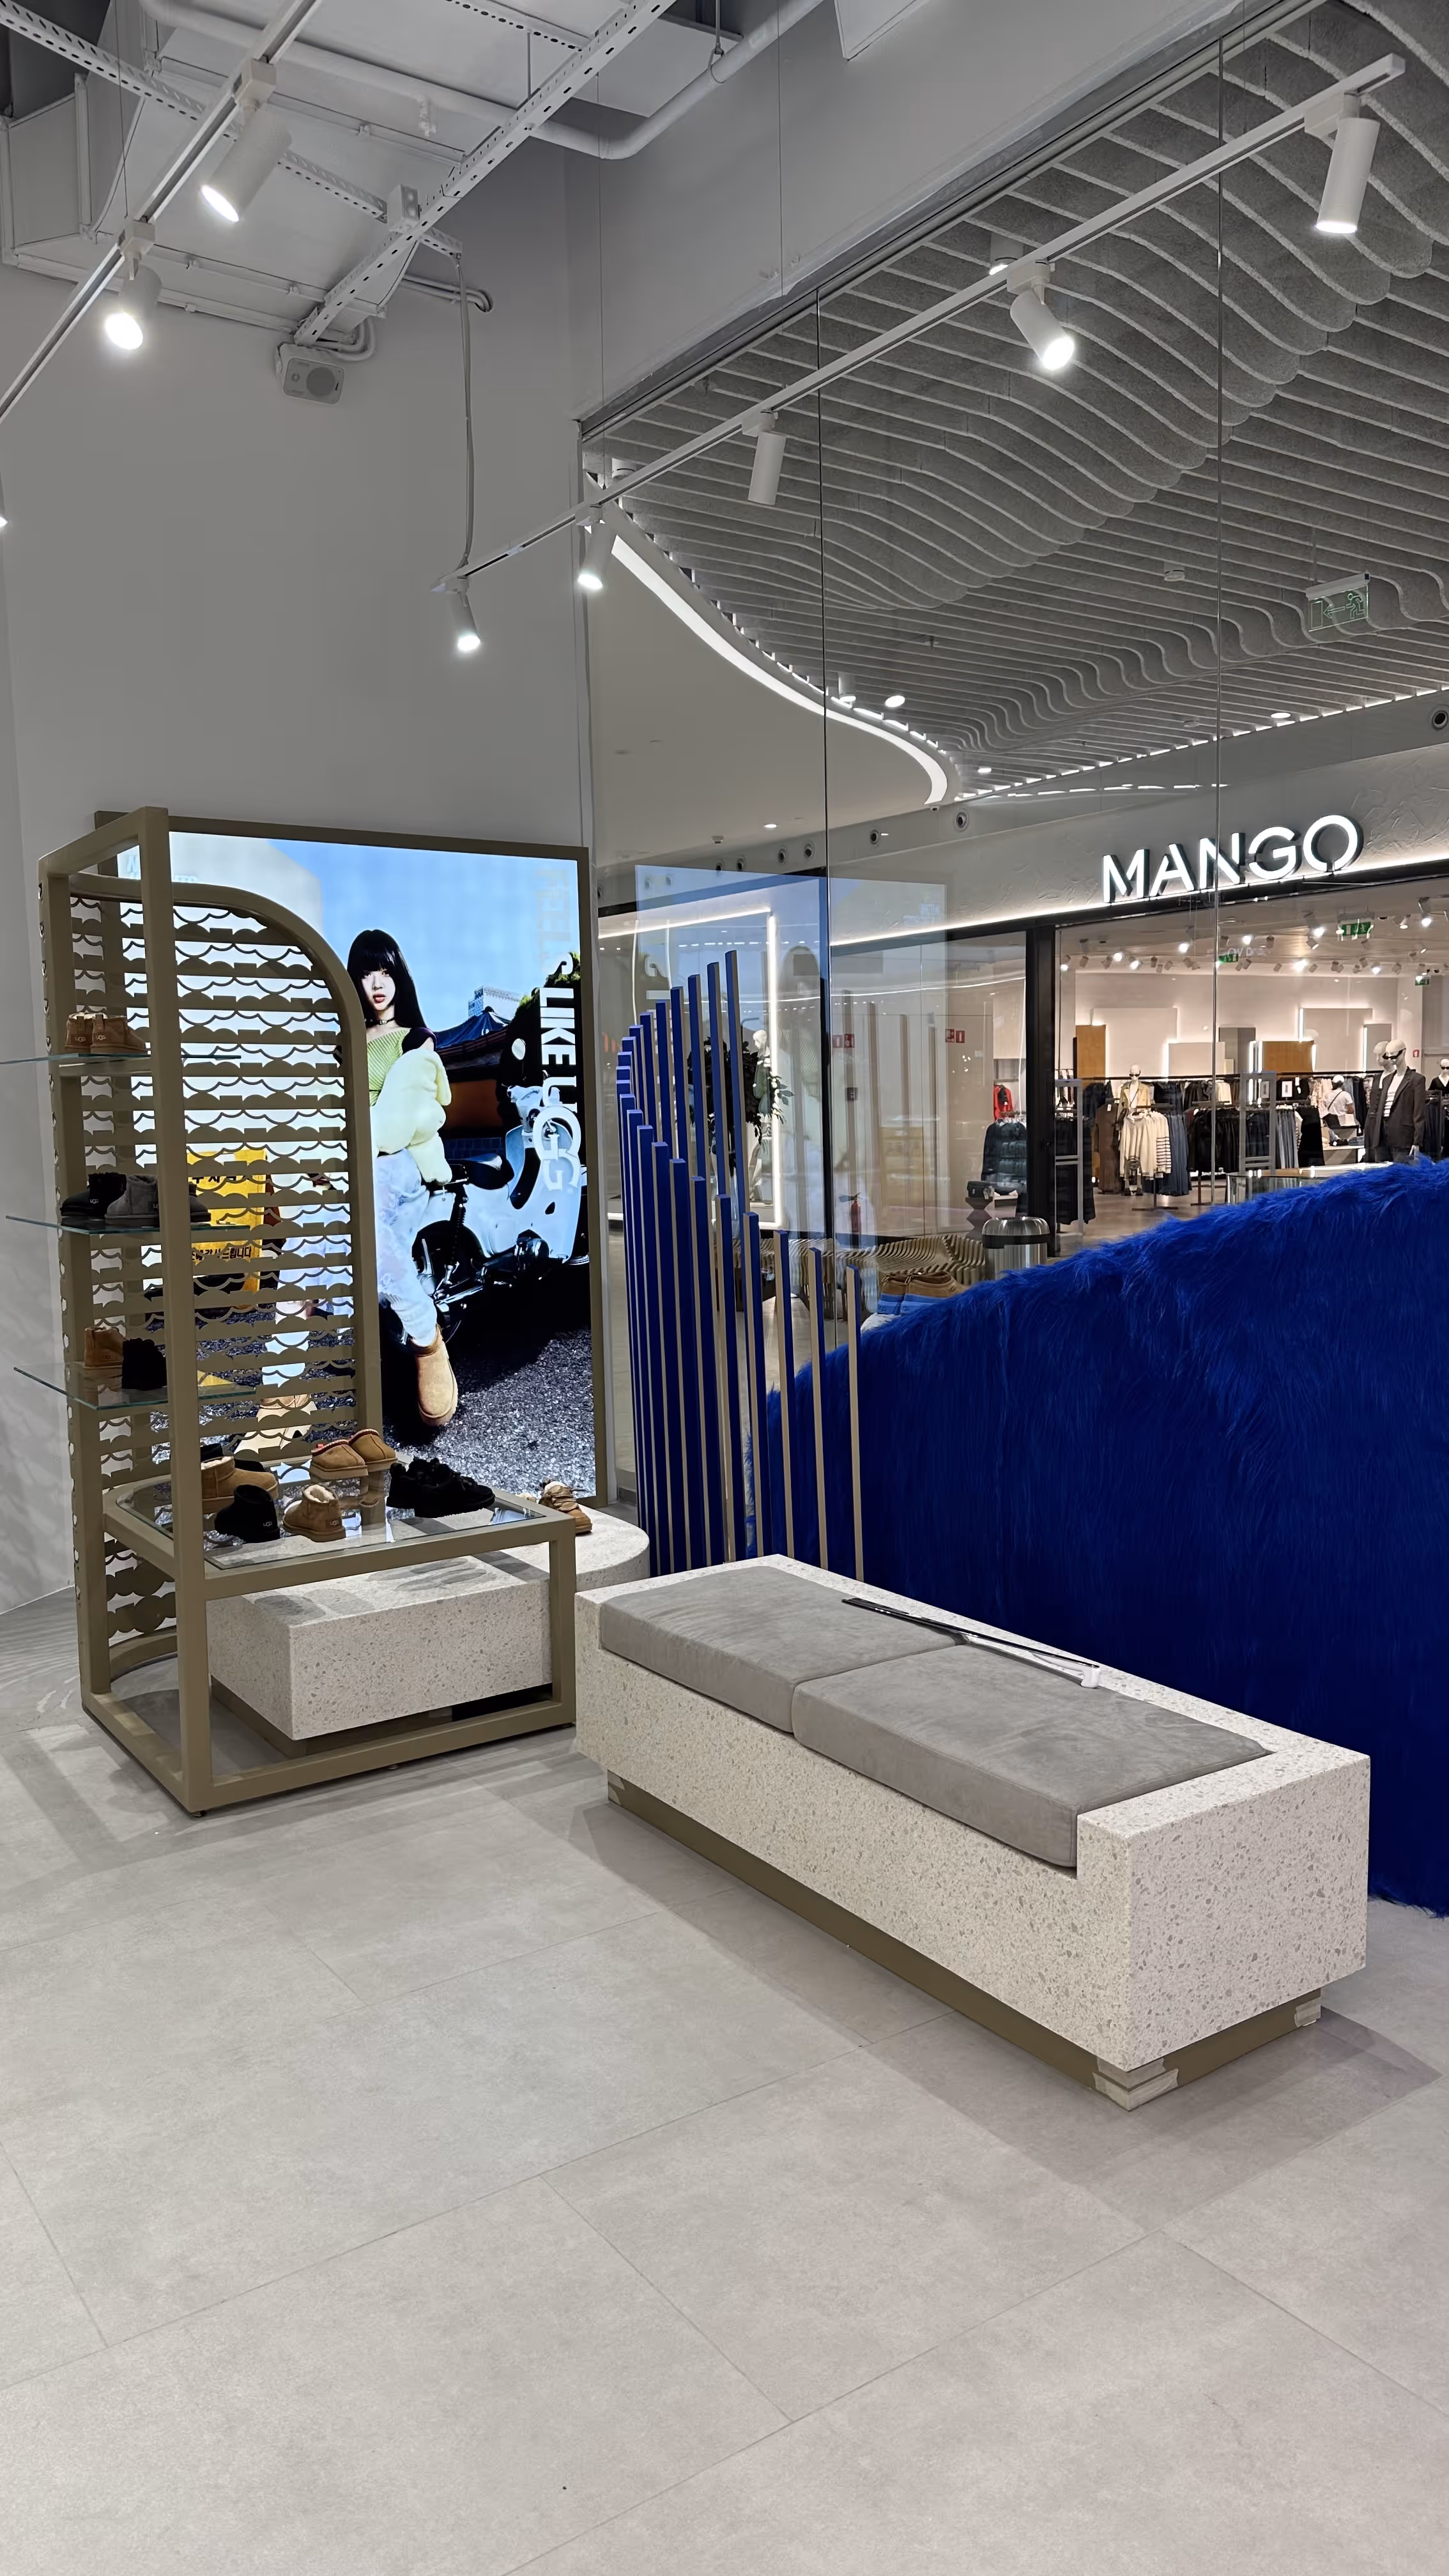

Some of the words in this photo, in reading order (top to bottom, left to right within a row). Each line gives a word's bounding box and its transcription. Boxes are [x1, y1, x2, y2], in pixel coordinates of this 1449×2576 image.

[1103, 815, 1361, 903] MANGO
[540, 988, 576, 1064] LIKE
[533, 1076, 581, 1191] UGG
